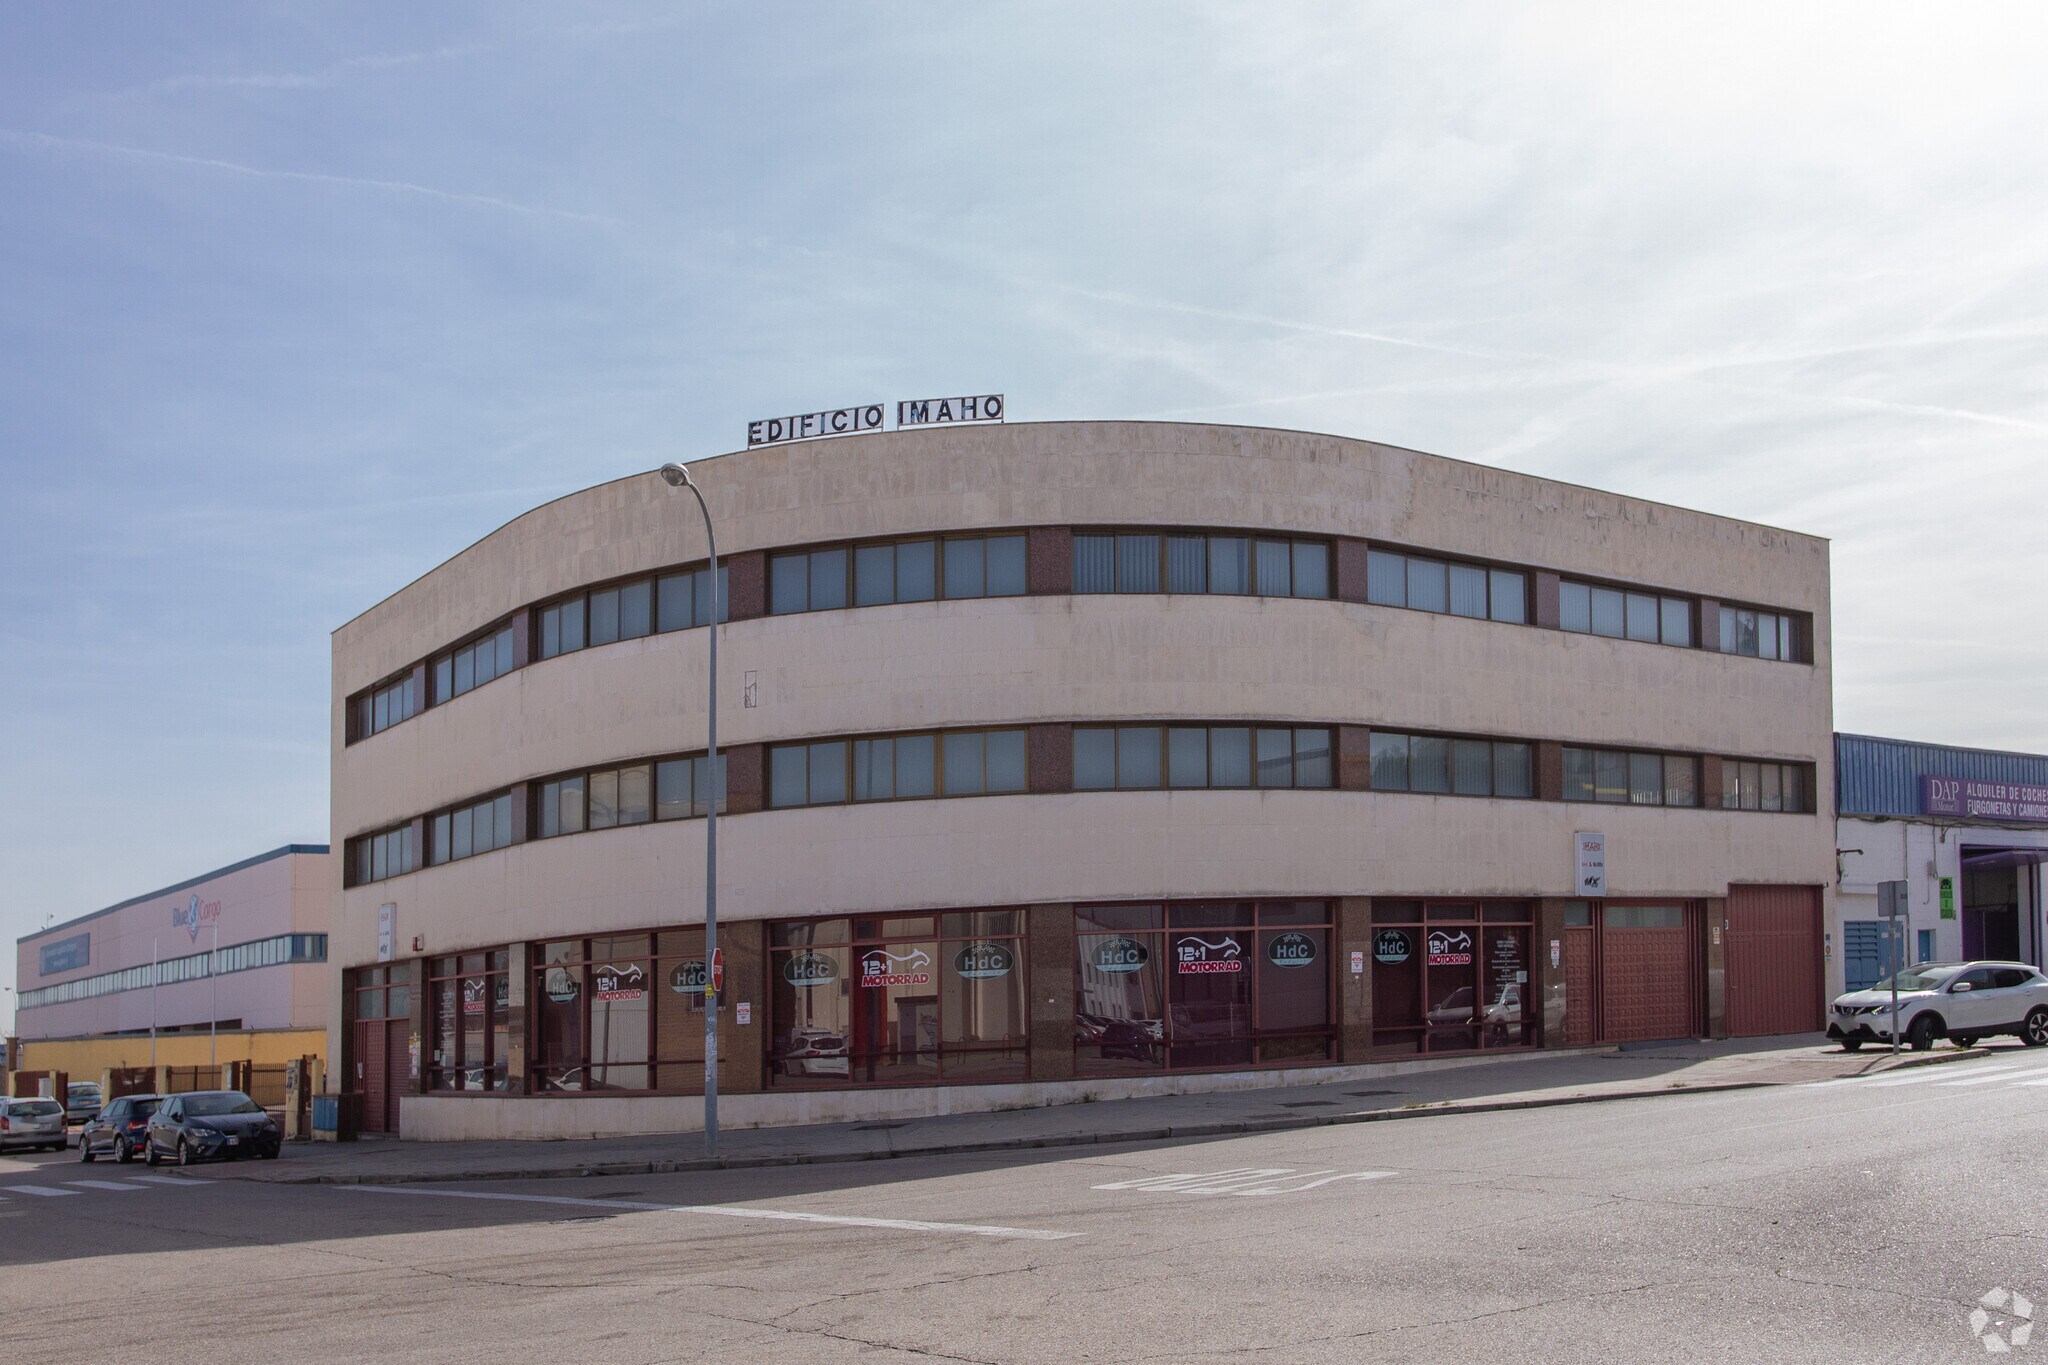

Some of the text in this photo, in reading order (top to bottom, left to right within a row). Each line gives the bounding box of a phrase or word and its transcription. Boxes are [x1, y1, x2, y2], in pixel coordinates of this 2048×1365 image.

[750, 396, 1002, 443] EDIFICIO IMAHO
[1931, 779, 1959, 800] DAP
[1967, 783, 2048, 802] ALQUILER DE COCHE
[1968, 800, 2011, 816] FURGONETAS
[2012, 803, 2018, 816] Y
[173, 899, 221, 928] Blue Cargo
[1177, 946, 1206, 961] 12+1
[1276, 944, 1308, 958] HdC
[1379, 941, 1405, 954] HdC
[1428, 940, 1448, 953] 12+1
[964, 955, 1003, 970] HdC
[1101, 949, 1138, 964] HdC
[1428, 953, 1471, 965] MOTORRAD
[794, 963, 829, 978] HdC
[862, 960, 892, 975] 12+1
[1178, 960, 1242, 974] MOTORRAD
[597, 976, 618, 991] 12+1
[676, 971, 706, 985] HdC
[862, 972, 930, 987] MOTORRAD
[597, 989, 642, 1002] MOTORRAD
